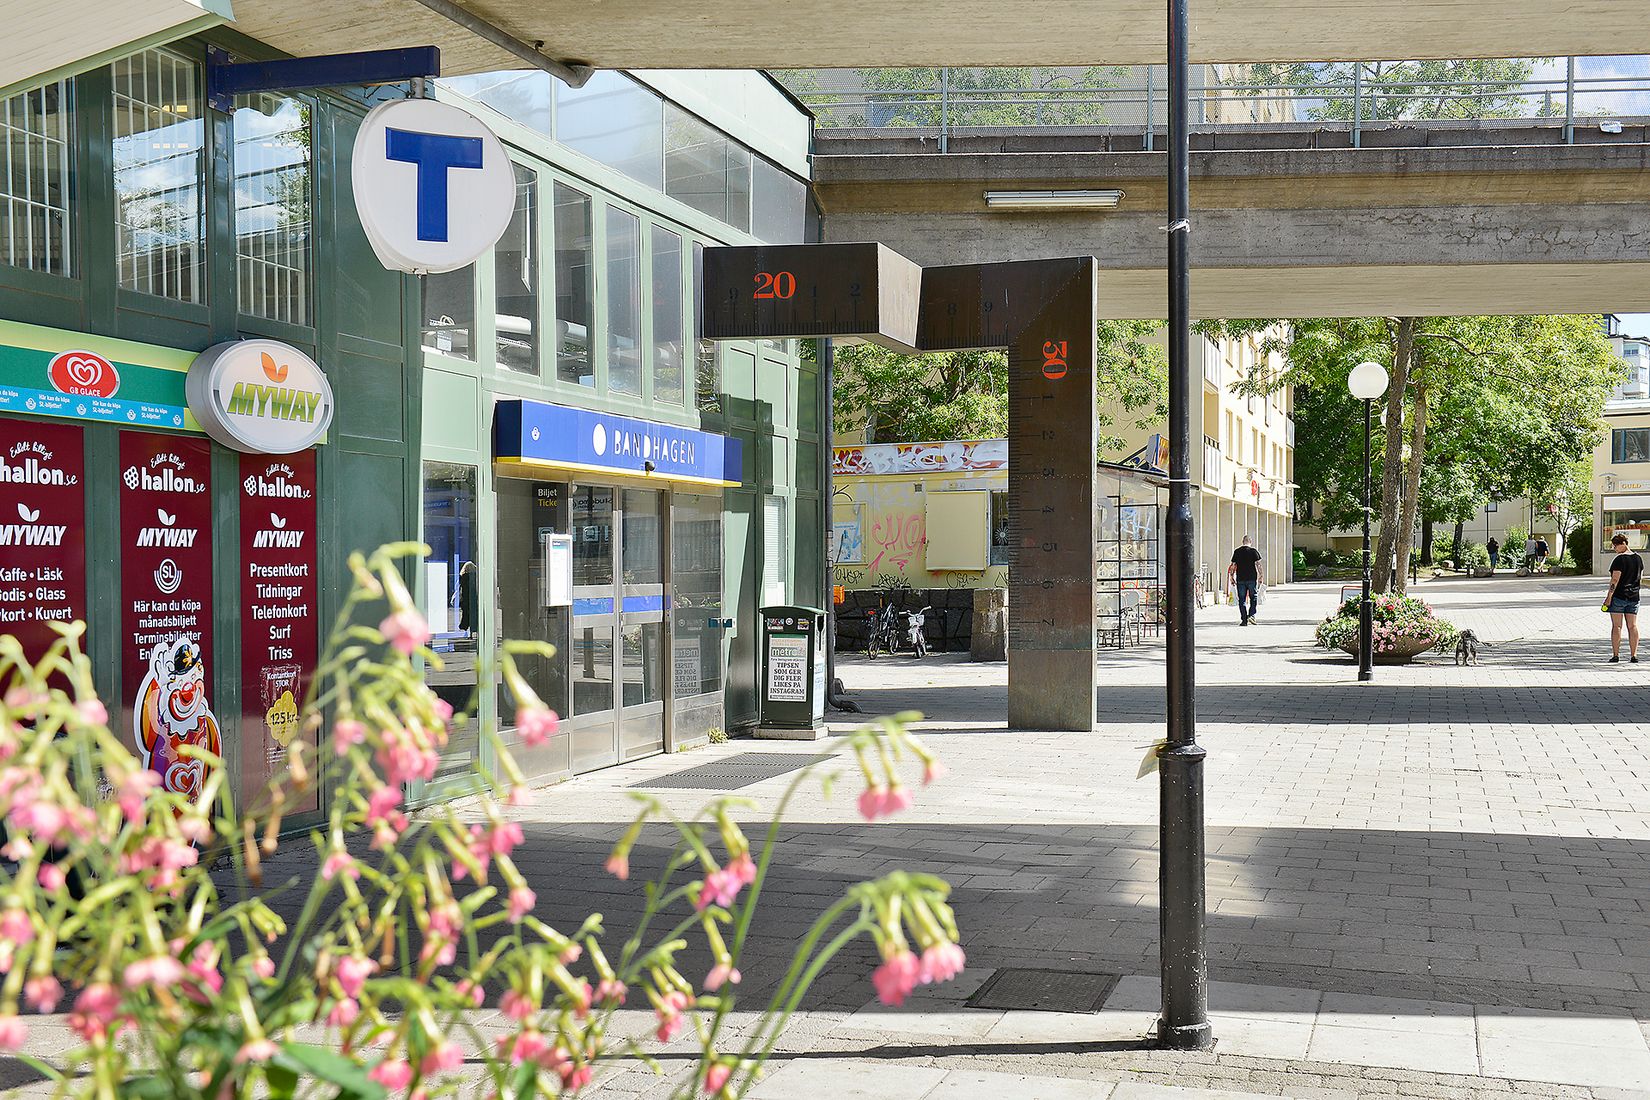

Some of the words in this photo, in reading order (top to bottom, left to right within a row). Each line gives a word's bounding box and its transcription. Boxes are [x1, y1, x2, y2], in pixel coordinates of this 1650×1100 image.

[385, 127, 483, 242] T
[753, 271, 796, 299] 20
[1042, 341, 1068, 380] 30
[69, 386, 79, 394] GB
[80, 388, 100, 397] GLACE
[227, 382, 322, 423] MYWAY
[614, 430, 695, 465] BANDHAGEN
[141, 467, 206, 493] hallon.se
[258, 476, 311, 499] hallon.se
[136, 528, 197, 547] MYWAY
[253, 530, 304, 548] MYWAY
[37, 567, 63, 581] Läsk
[162, 565, 174, 579] SL
[250, 563, 308, 578] Presentkort
[36, 587, 66, 600] Glass
[256, 584, 303, 600] Tidningar
[0, 608, 25, 622] kort
[35, 606, 72, 620] Kuvert
[133, 600, 150, 613] Här
[151, 600, 168, 612] kan
[169, 600, 180, 611] du
[181, 599, 201, 613] köpa
[251, 604, 308, 620] Telefonkort
[139, 614, 197, 629] månadsbiljett
[133, 631, 202, 644] Terminsbiljetter
[269, 625, 291, 640] Surf
[268, 646, 293, 661] Triss
[271, 712, 285, 725] 125
[287, 711, 296, 724] kr
